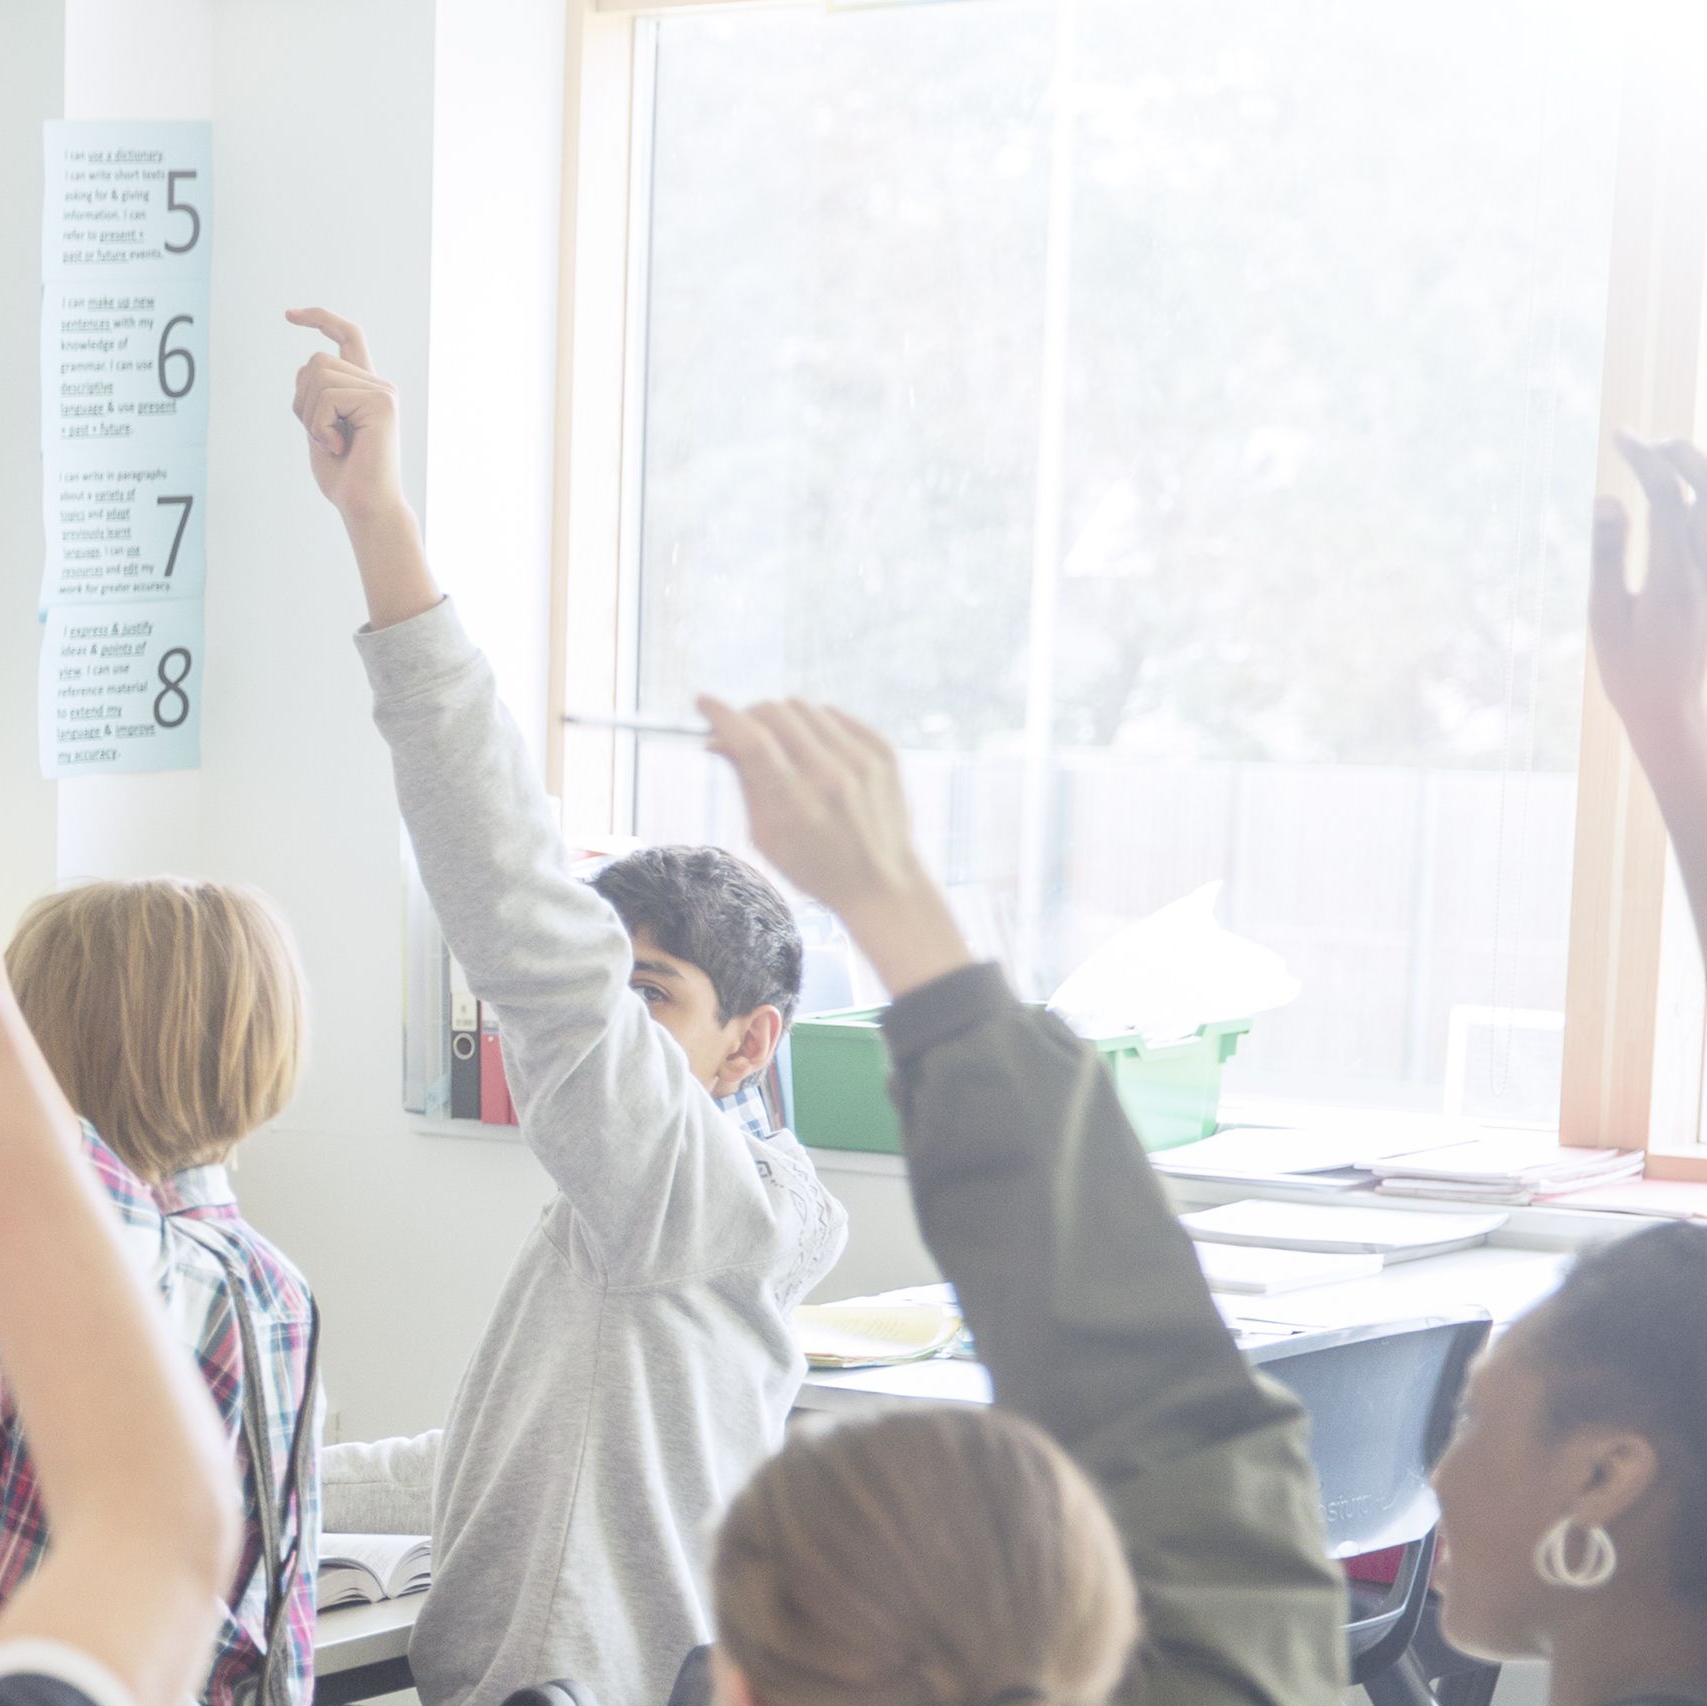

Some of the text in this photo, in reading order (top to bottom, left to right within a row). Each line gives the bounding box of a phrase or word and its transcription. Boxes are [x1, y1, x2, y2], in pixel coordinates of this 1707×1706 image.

[164, 168, 201, 254] 5
[157, 313, 196, 399] 6
[156, 494, 194, 579] 7
[153, 646, 192, 729] 8
